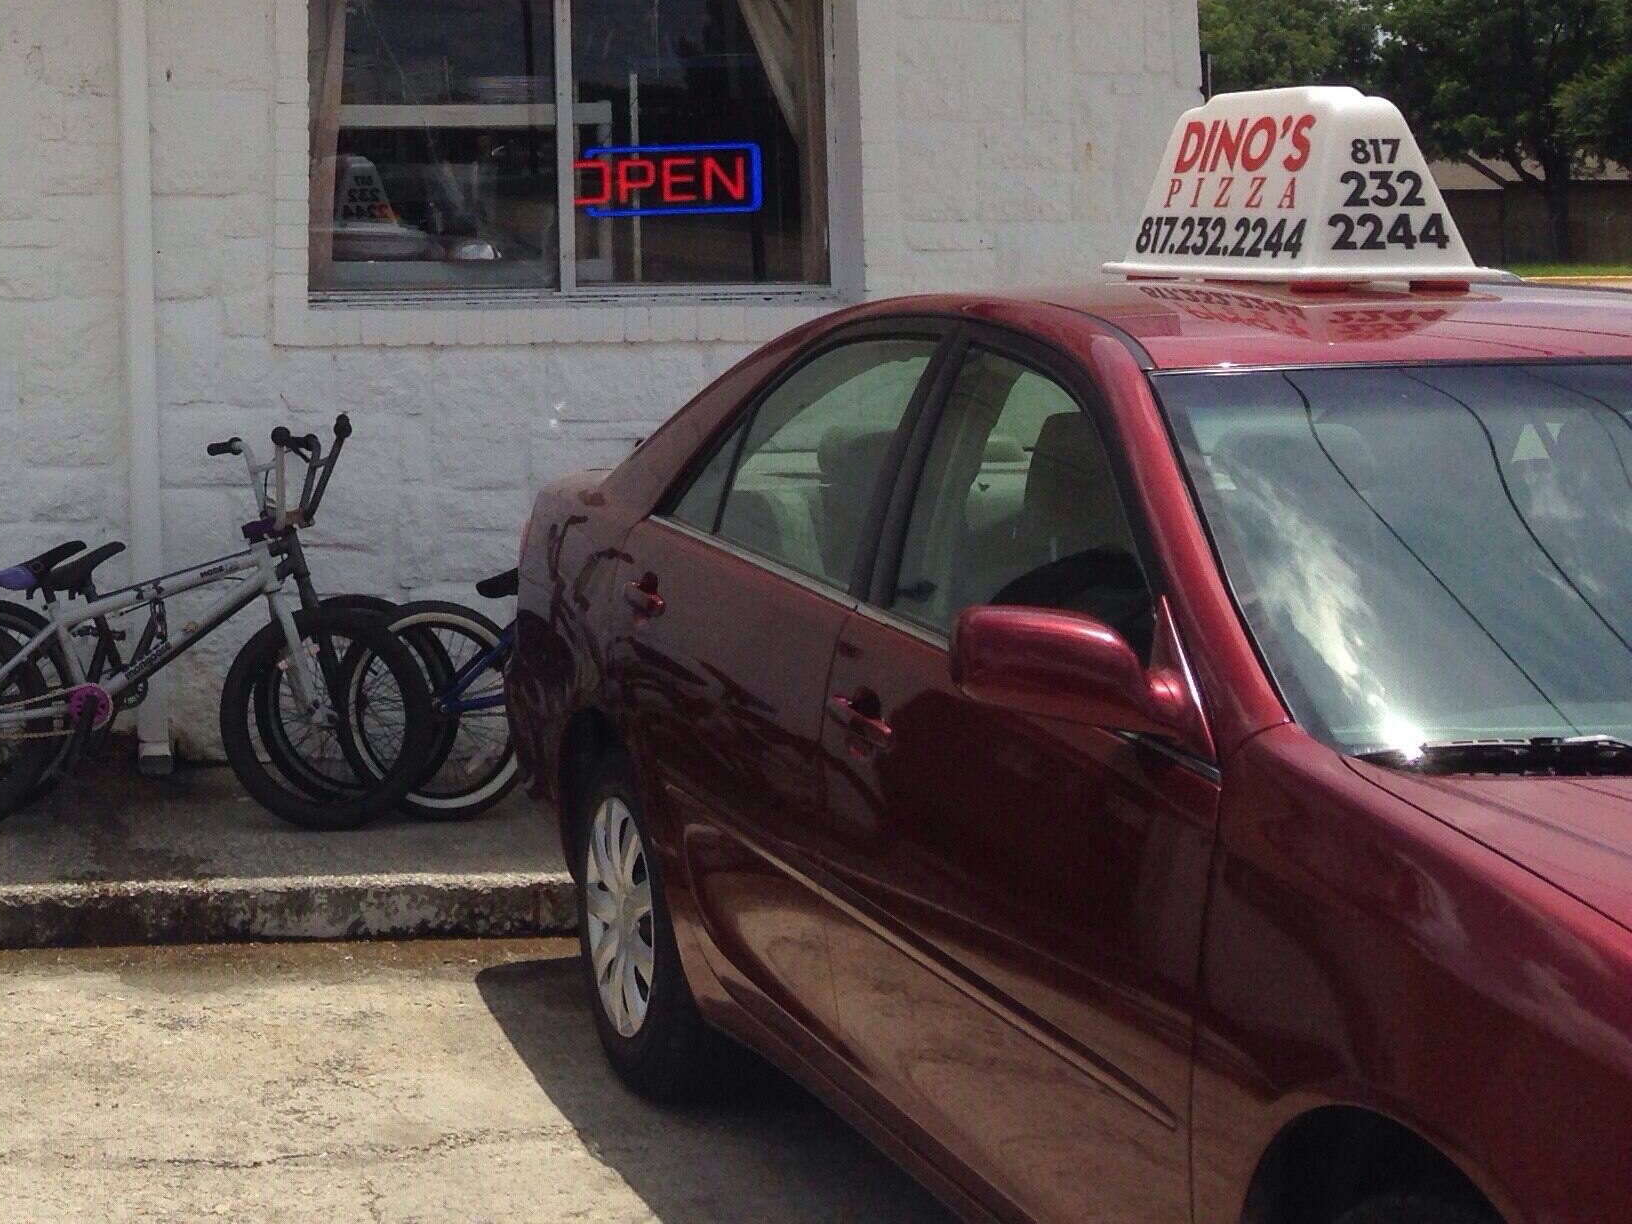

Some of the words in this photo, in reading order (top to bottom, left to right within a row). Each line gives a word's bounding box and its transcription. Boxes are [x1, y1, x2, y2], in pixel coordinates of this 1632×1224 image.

[1173, 114, 1317, 174] DINO'S
[1351, 138, 1400, 165] 817
[1164, 177, 1297, 209] PIZZA
[1340, 170, 1426, 208] 232
[1135, 216, 1307, 259] 817.232.2244
[1327, 213, 1450, 251] 2244
